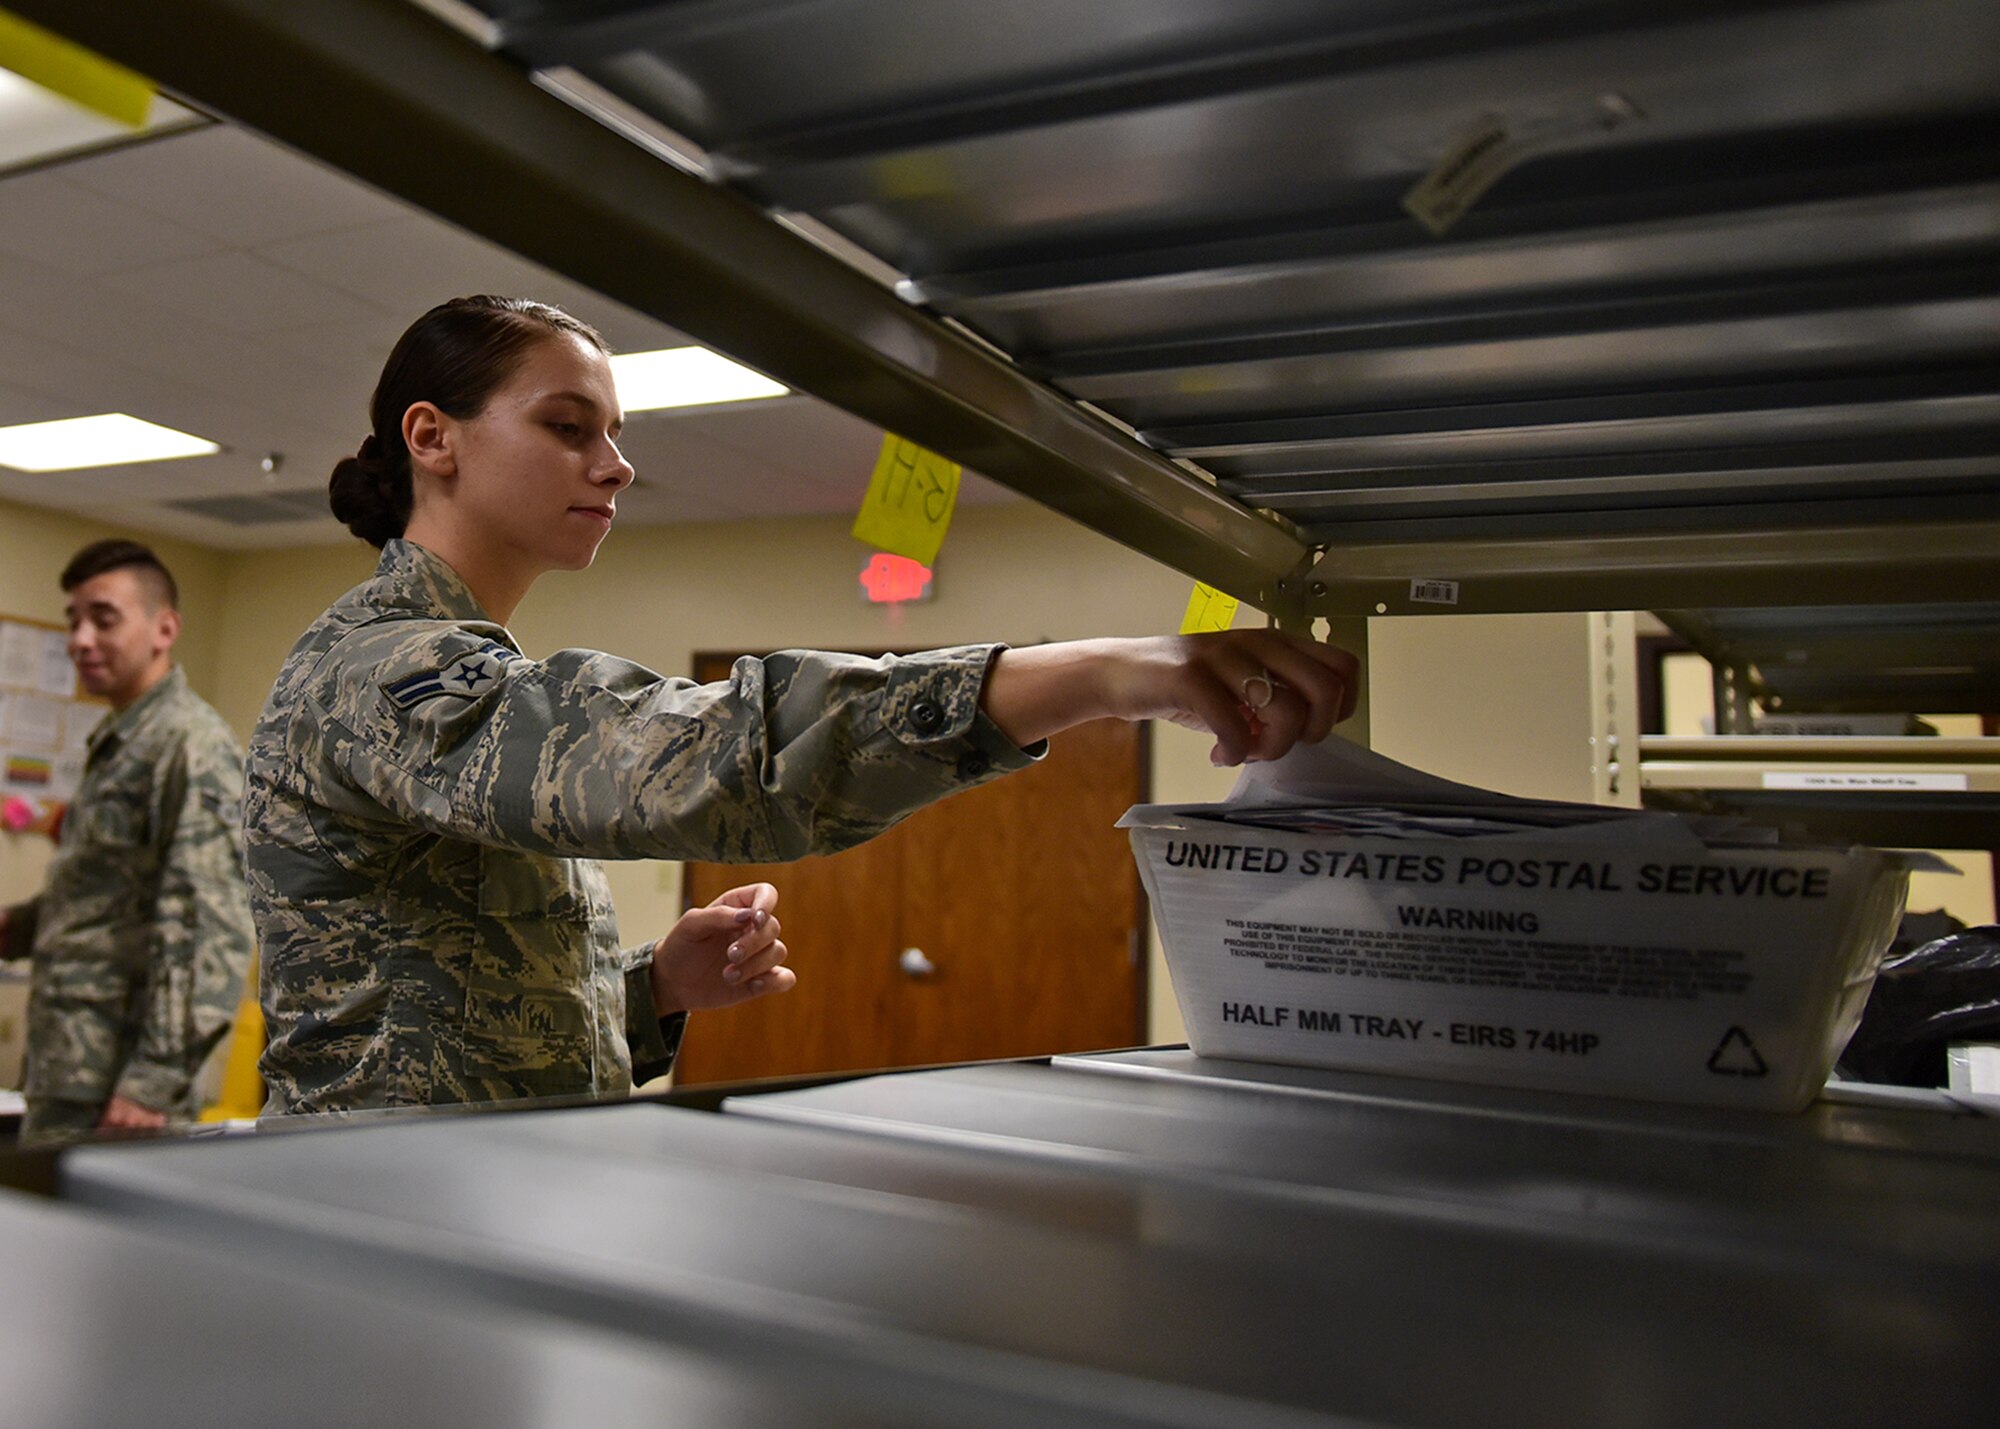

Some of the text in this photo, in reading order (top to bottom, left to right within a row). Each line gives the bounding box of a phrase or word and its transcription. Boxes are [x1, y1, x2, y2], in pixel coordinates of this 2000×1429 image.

[1165, 841, 1830, 898] UNITED STATES POSTAL SERVICE
[1225, 919, 1245, 928] THIS
[1246, 921, 1297, 932] EQUIPMENT
[1299, 926, 1320, 934] MAY
[1321, 927, 1340, 936] NOT
[1343, 929, 1355, 937] BE
[1358, 930, 1385, 939] SOLD
[1386, 932, 1400, 940] OR
[1402, 933, 1456, 944] RECYCLED
[1397, 905, 1540, 935] WARNING
[1223, 938, 1276, 950] PROHIBITED
[1278, 943, 1291, 951] BY
[1292, 943, 1333, 955] FEDERAL
[1363, 950, 1382, 958] THE
[1385, 951, 1421, 961] POSTAL
[1241, 930, 1259, 939] USE
[1261, 932, 1273, 940] OF
[1275, 933, 1295, 942] THIS
[1297, 935, 1349, 946] EQUIPMENT
[1352, 939, 1372, 948] FOR
[1375, 941, 1394, 949] ANY
[1396, 942, 1441, 953] PURPOSE
[1230, 948, 1289, 961] TECHNOLOGY
[1291, 954, 1304, 962] TO
[1306, 955, 1348, 966] MONITOR
[1350, 959, 1369, 967] THE
[1371, 961, 1420, 972] LOCATION
[1422, 964, 1435, 972] OF
[1264, 961, 1332, 973] IMPRISONMENT
[1334, 967, 1347, 975] OF
[1350, 969, 1363, 977] UP
[1365, 970, 1379, 978] TO
[1381, 971, 1411, 981] THREE
[1222, 1001, 1601, 1056] HALF MM TRAY - EIRS 74HP
